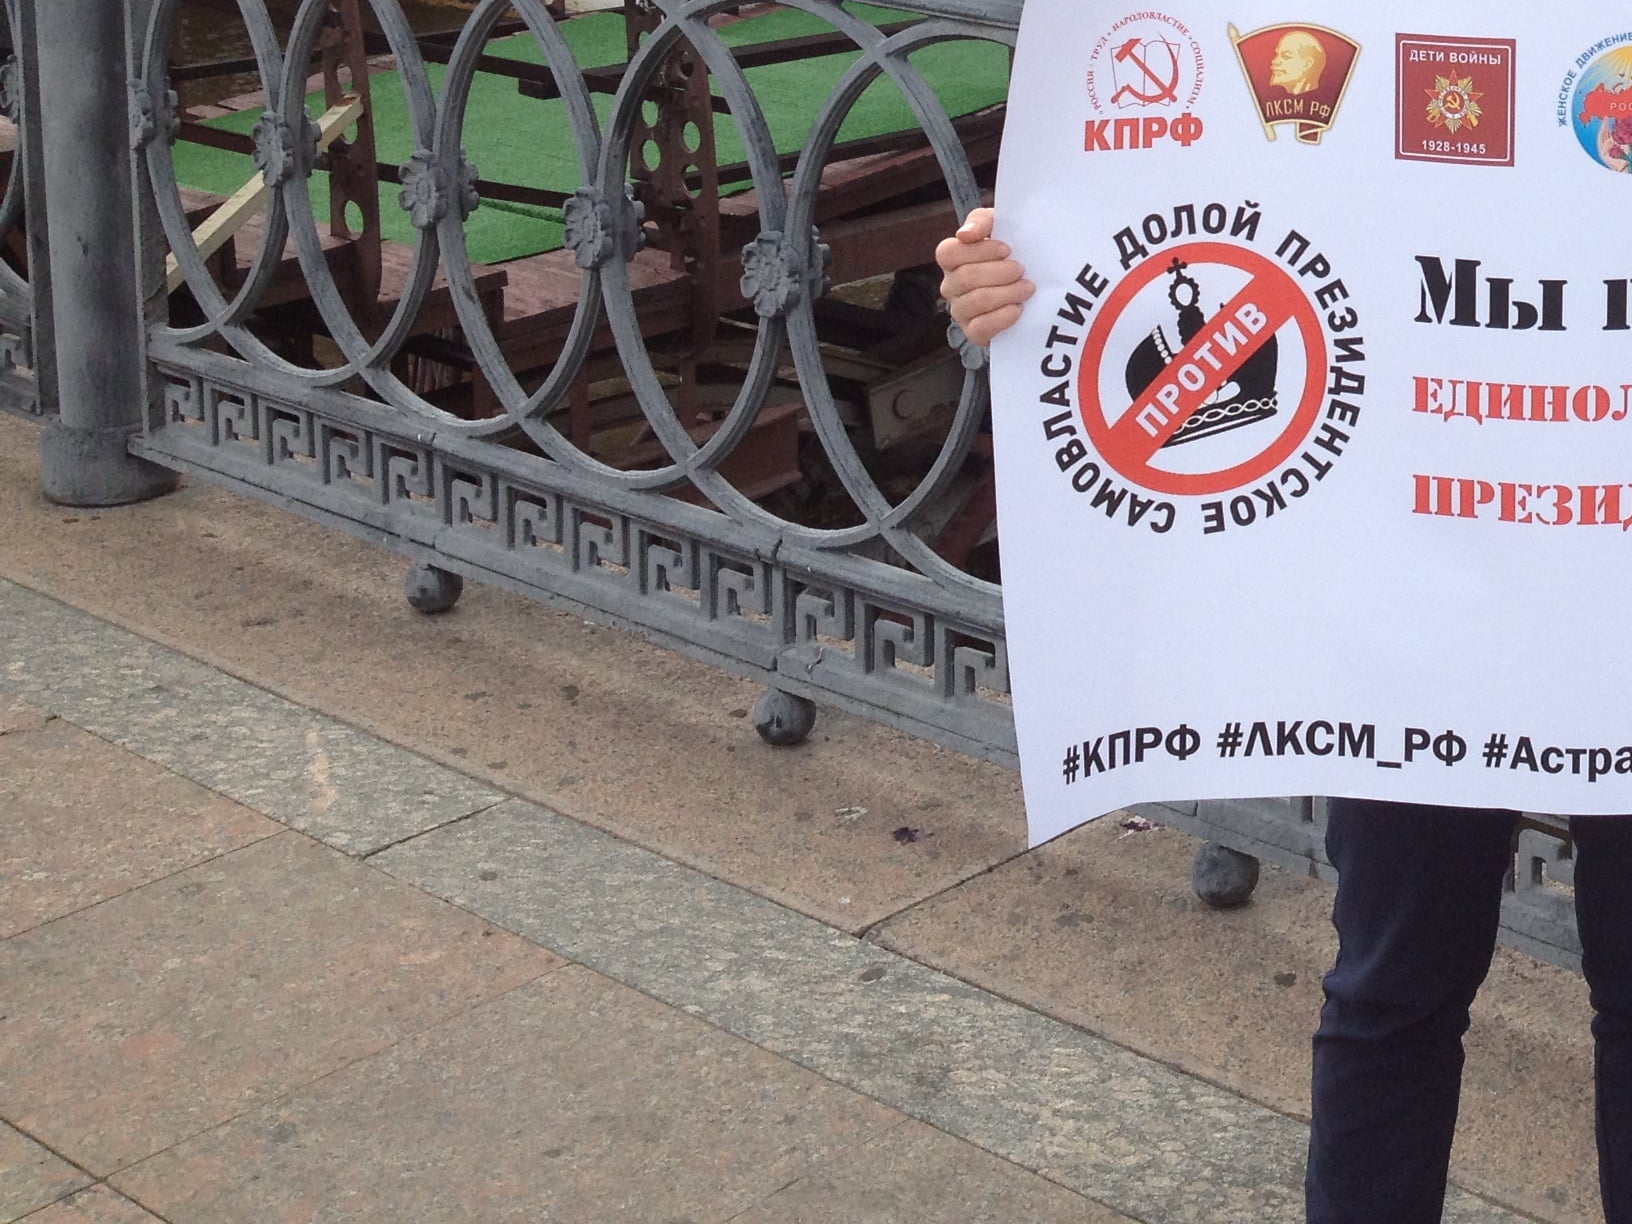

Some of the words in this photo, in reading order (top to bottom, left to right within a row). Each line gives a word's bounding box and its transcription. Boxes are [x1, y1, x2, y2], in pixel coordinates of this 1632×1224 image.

[1409, 49, 1444, 63] ДЕТИ
[1449, 51, 1502, 65] ВОЙНЫ
[1087, 70, 1102, 110] РОССИЯ
[1266, 98, 1304, 118] ЛКСМ
[1310, 102, 1331, 118] РФ
[1557, 70, 1577, 127] ЖЕНСКОЕ
[1084, 112, 1203, 152] КПРФ
[1422, 139, 1486, 154] 1928-1945
[1040, 263, 1176, 534] САМОВЛАСТИЕ
[1113, 199, 1262, 271] ДОЛОЙ
[1200, 229, 1366, 535] ПРЕЗИДЕНТСКОЕ
[1135, 302, 1269, 438] ПРОТИВ
[1062, 723, 1202, 786] #КПРФ
[1216, 719, 1468, 769] #ЛКСМ_РФ
